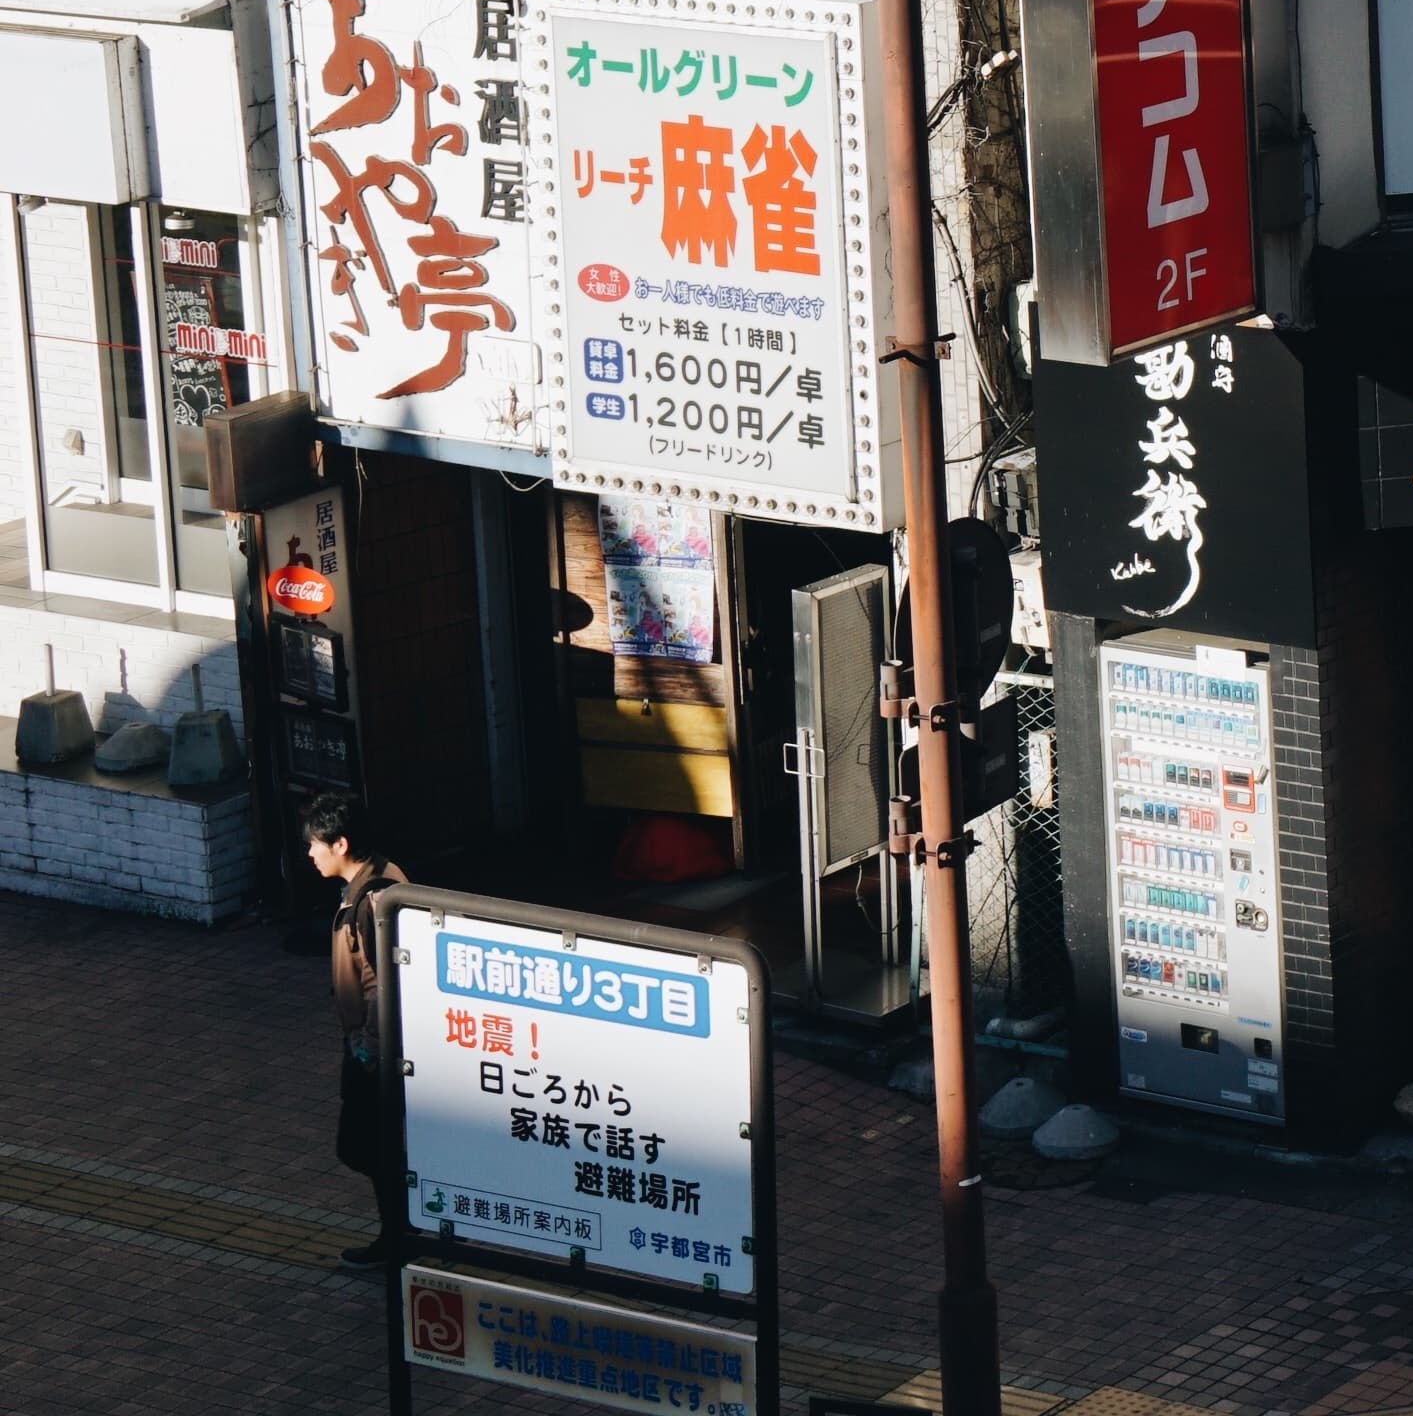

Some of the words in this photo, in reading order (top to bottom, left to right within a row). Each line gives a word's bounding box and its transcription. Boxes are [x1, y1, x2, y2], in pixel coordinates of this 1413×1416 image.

[566, 41, 814, 108] オールグリーン
[1155, 247, 1208, 313] 2F
[592, 396, 621, 416] 学生
[316, 500, 338, 576] 居酒屋
[276, 577, 326, 603] Coca-Cola
[446, 941, 696, 1028] 駅前通り3丁目
[480, 1062, 633, 1117] 日ごろから
[511, 1108, 666, 1165] 家族で話す
[574, 1161, 701, 1216] 避難場所
[454, 1193, 592, 1242] 避難場所案内板
[651, 1232, 731, 1268] 宇都宮市
